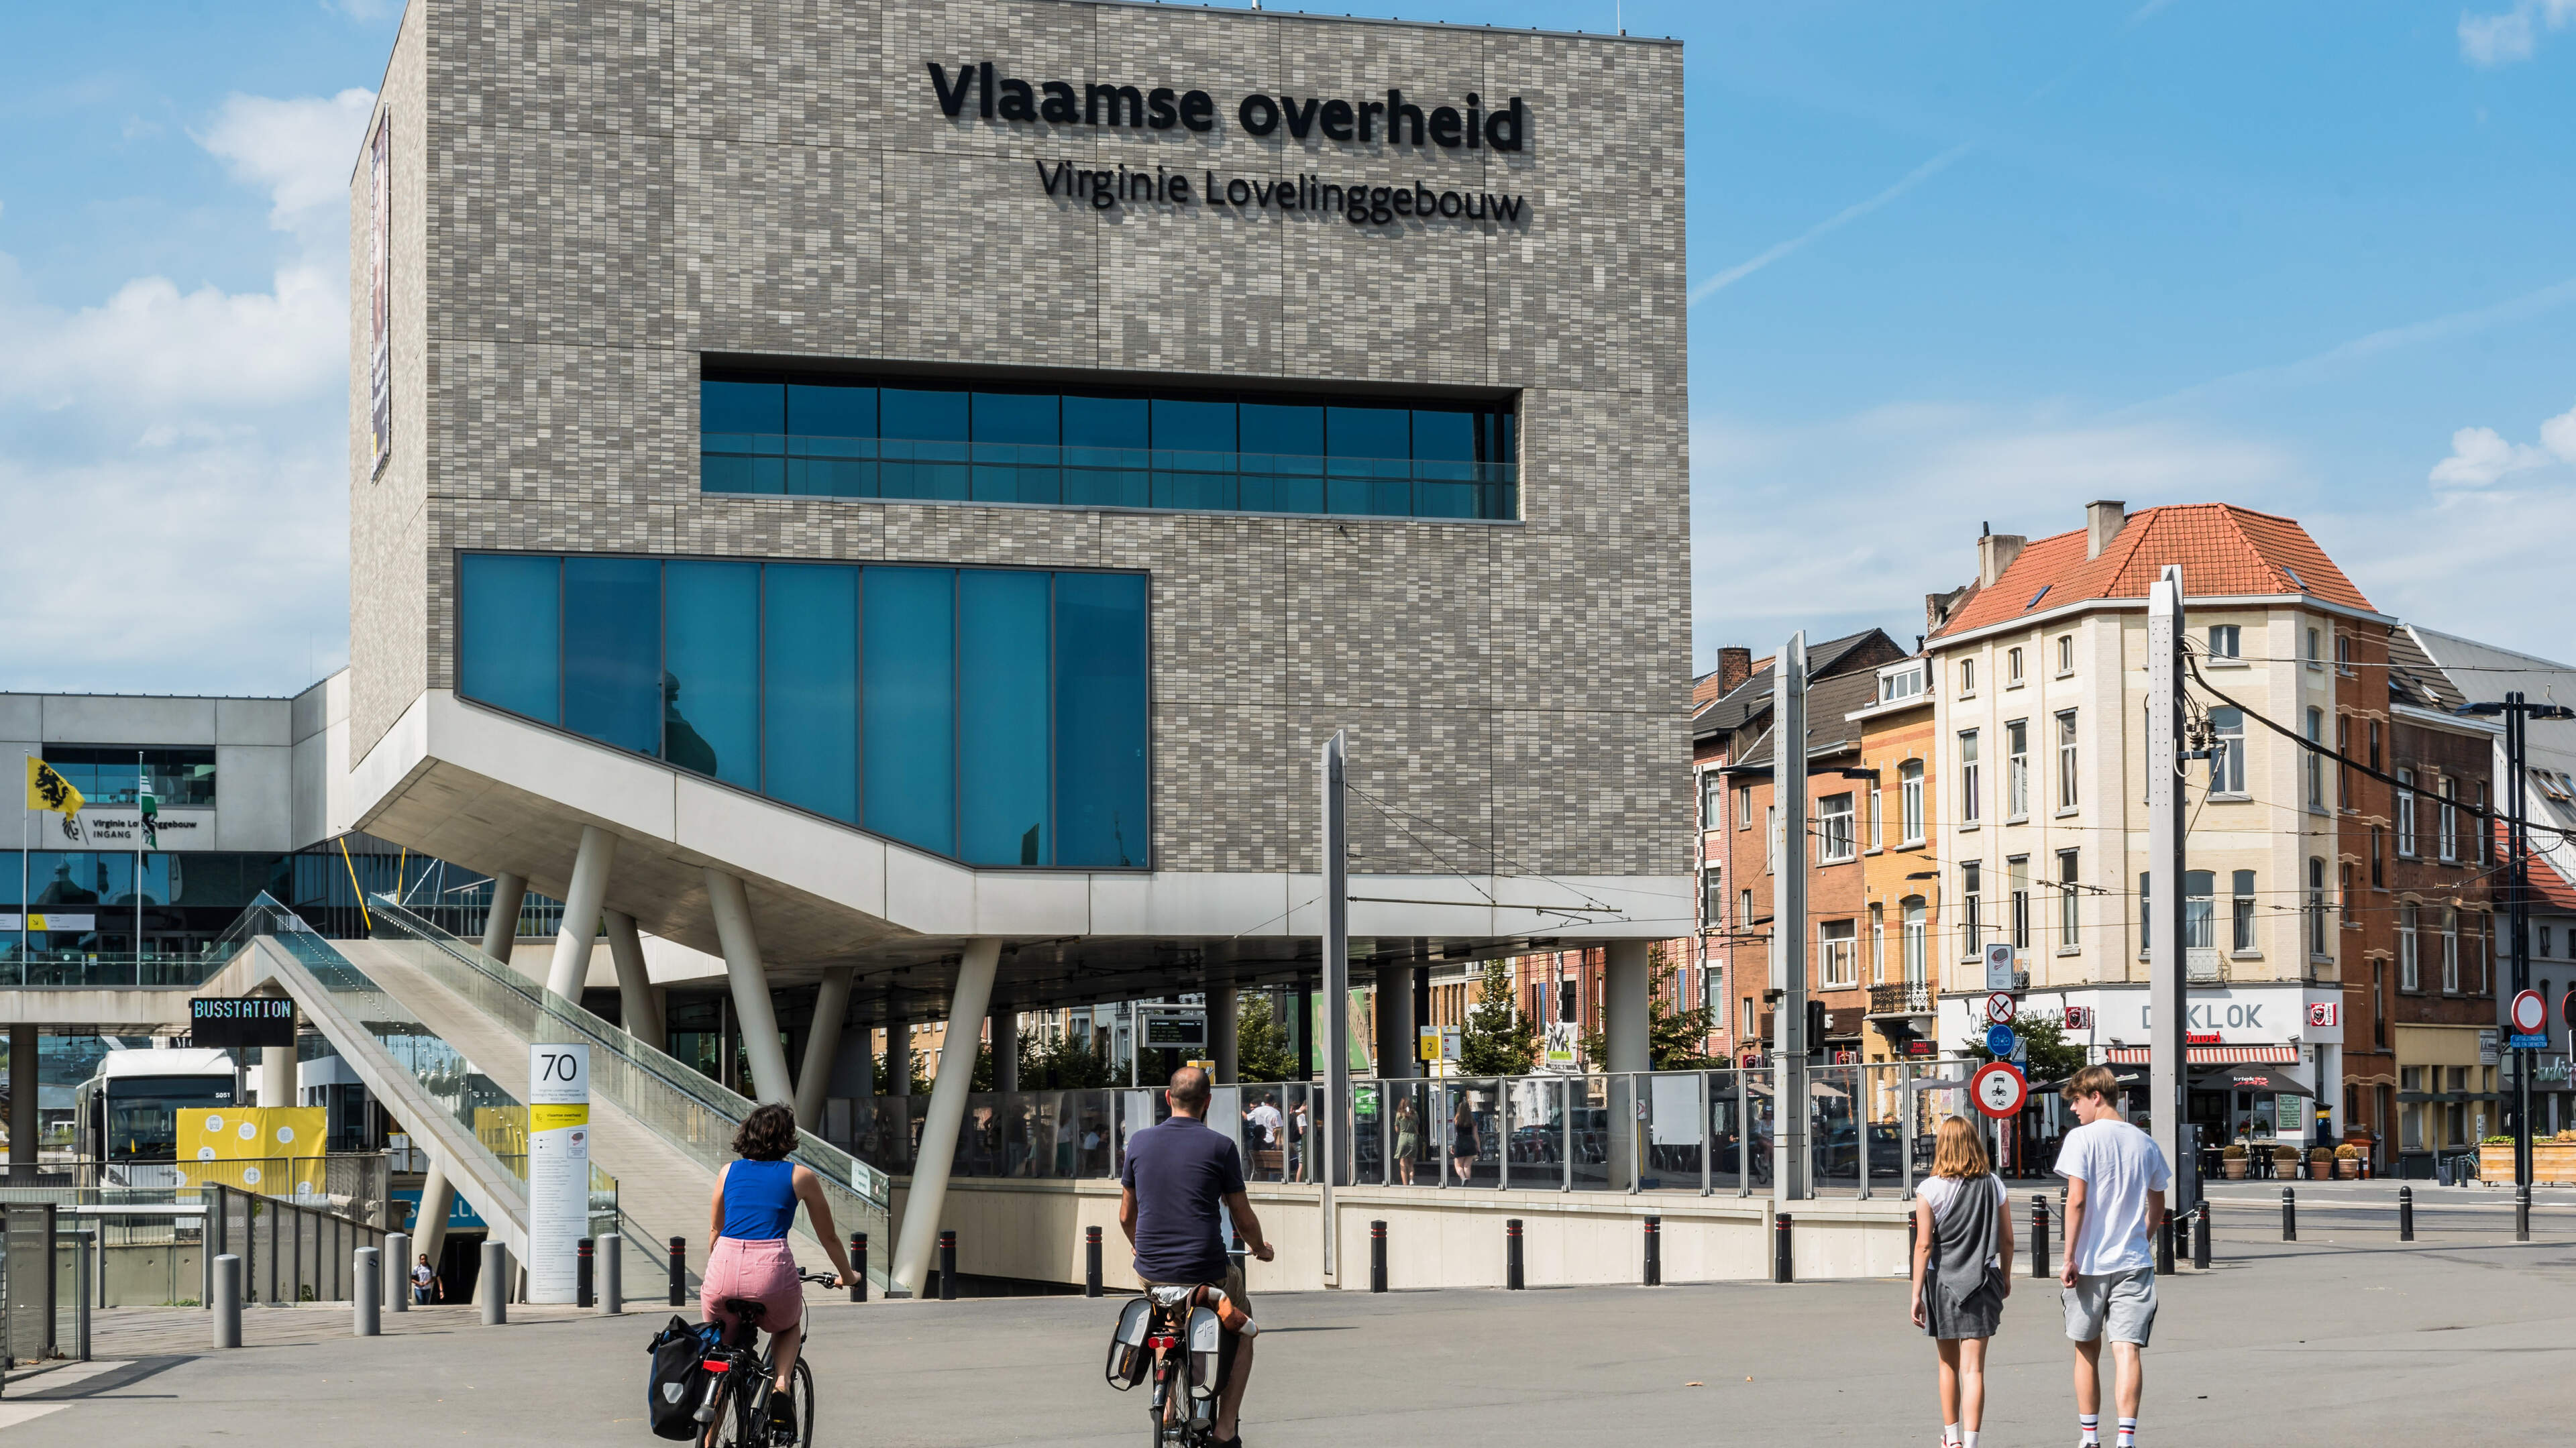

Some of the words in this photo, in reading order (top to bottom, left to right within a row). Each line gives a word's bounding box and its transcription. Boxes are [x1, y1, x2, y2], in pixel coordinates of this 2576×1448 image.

[927, 62, 1213, 132] Vlaamse
[1239, 89, 1522, 152] overheid
[1036, 160, 1188, 209] Virginie
[1206, 170, 1523, 224] Lovelinggebouw
[93, 820, 125, 828] Virginie
[93, 830, 131, 838] INGANG
[194, 1001, 290, 1018] BUSSTATION
[2186, 1004, 2263, 1029] KLOK
[1427, 1042, 1433, 1052] 2
[541, 1054, 577, 1082] 70
